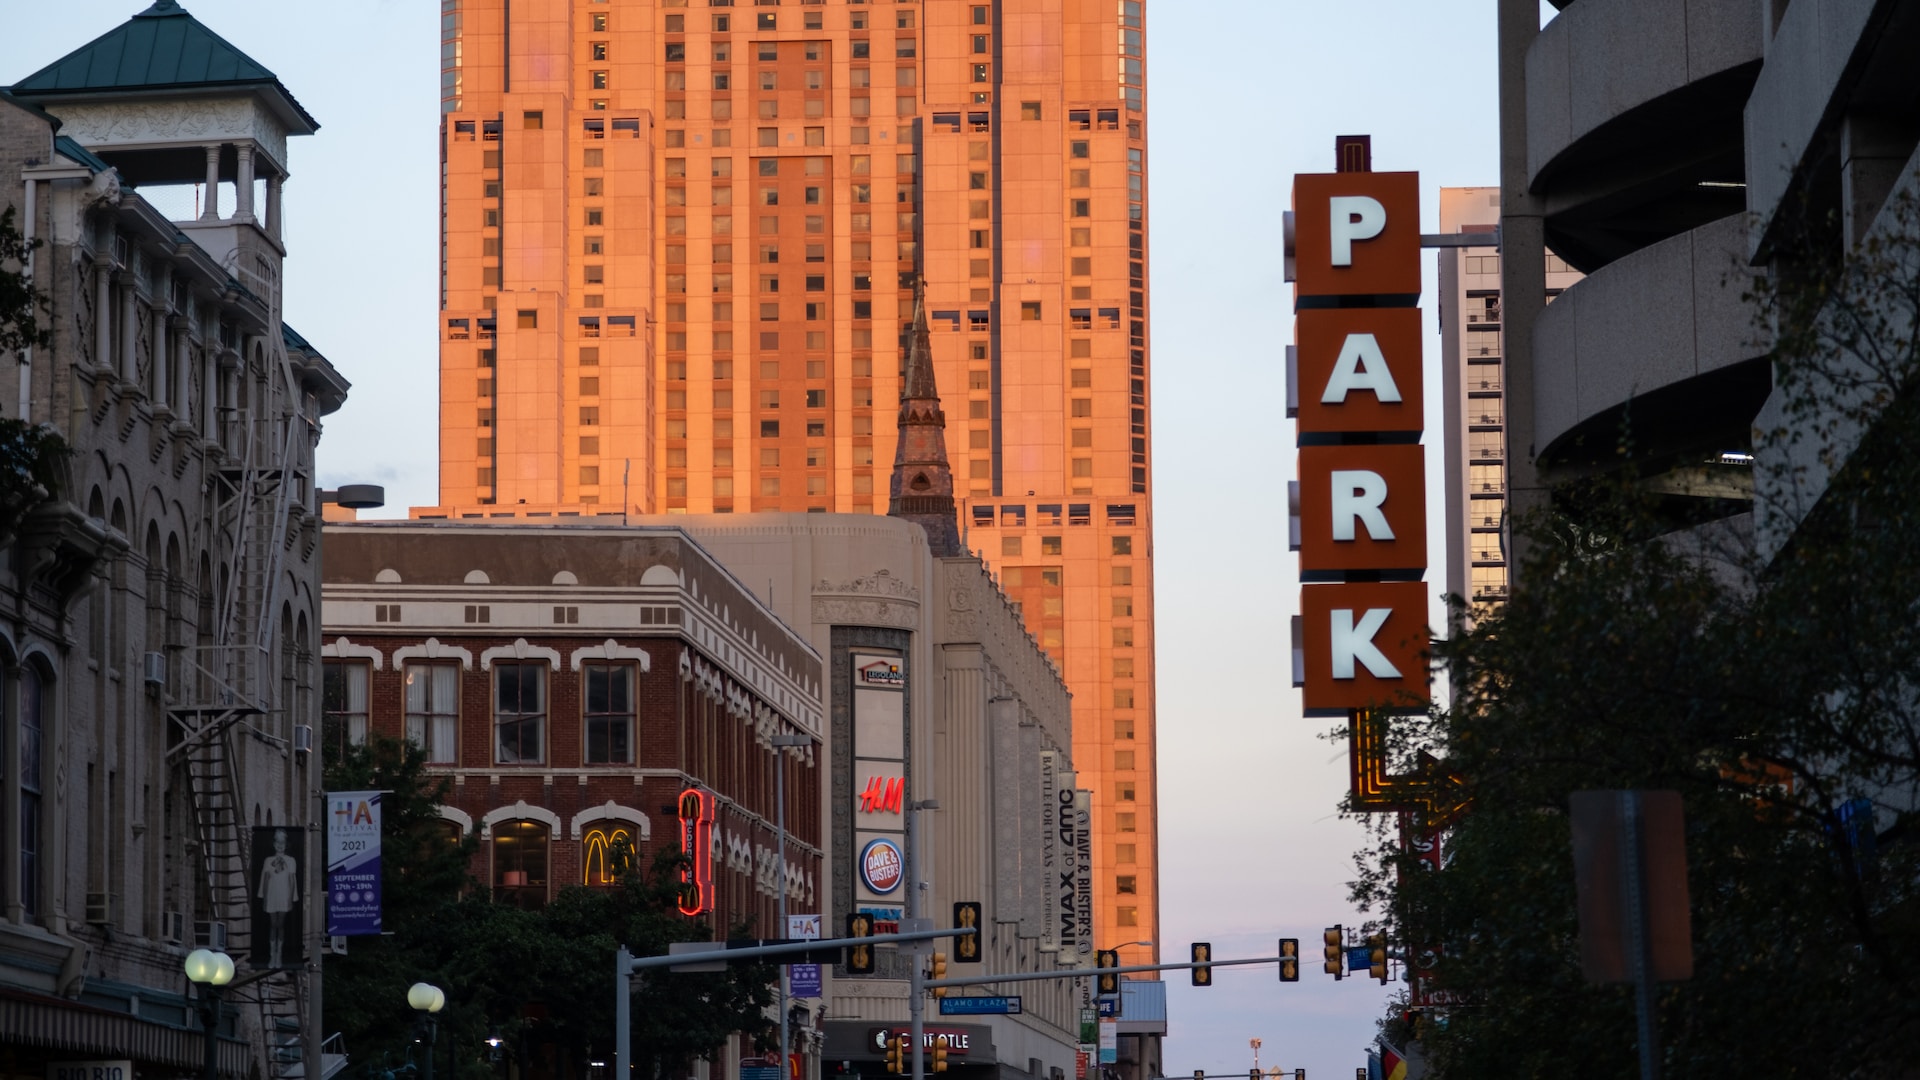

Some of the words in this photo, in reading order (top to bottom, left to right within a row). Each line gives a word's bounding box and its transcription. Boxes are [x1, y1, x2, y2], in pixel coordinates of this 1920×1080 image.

[1320, 194, 1403, 680] PARK
[868, 671, 904, 680] LEGOLAND
[1042, 756, 1052, 800] BATTLE
[859, 776, 905, 814] H&M
[1043, 803, 1053, 826] FOR
[342, 841, 366, 850] 2021
[1043, 828, 1053, 867] TEXAS
[1077, 830, 1090, 860] DAVE
[868, 851, 890, 870] DAVE
[889, 850, 898, 864] &
[1062, 852, 1074, 867] at
[1078, 865, 1089, 874] &
[334, 874, 375, 882] SEPTEMBER
[869, 864, 899, 882] BUSTER'S
[1061, 872, 1076, 945] IMAX
[1078, 878, 1090, 936] BUSTER'S
[1044, 892, 1052, 945] EXPERIENCE
[1099, 1002, 1111, 1012] IFE
[901, 1033, 969, 1048] CIPTLE
